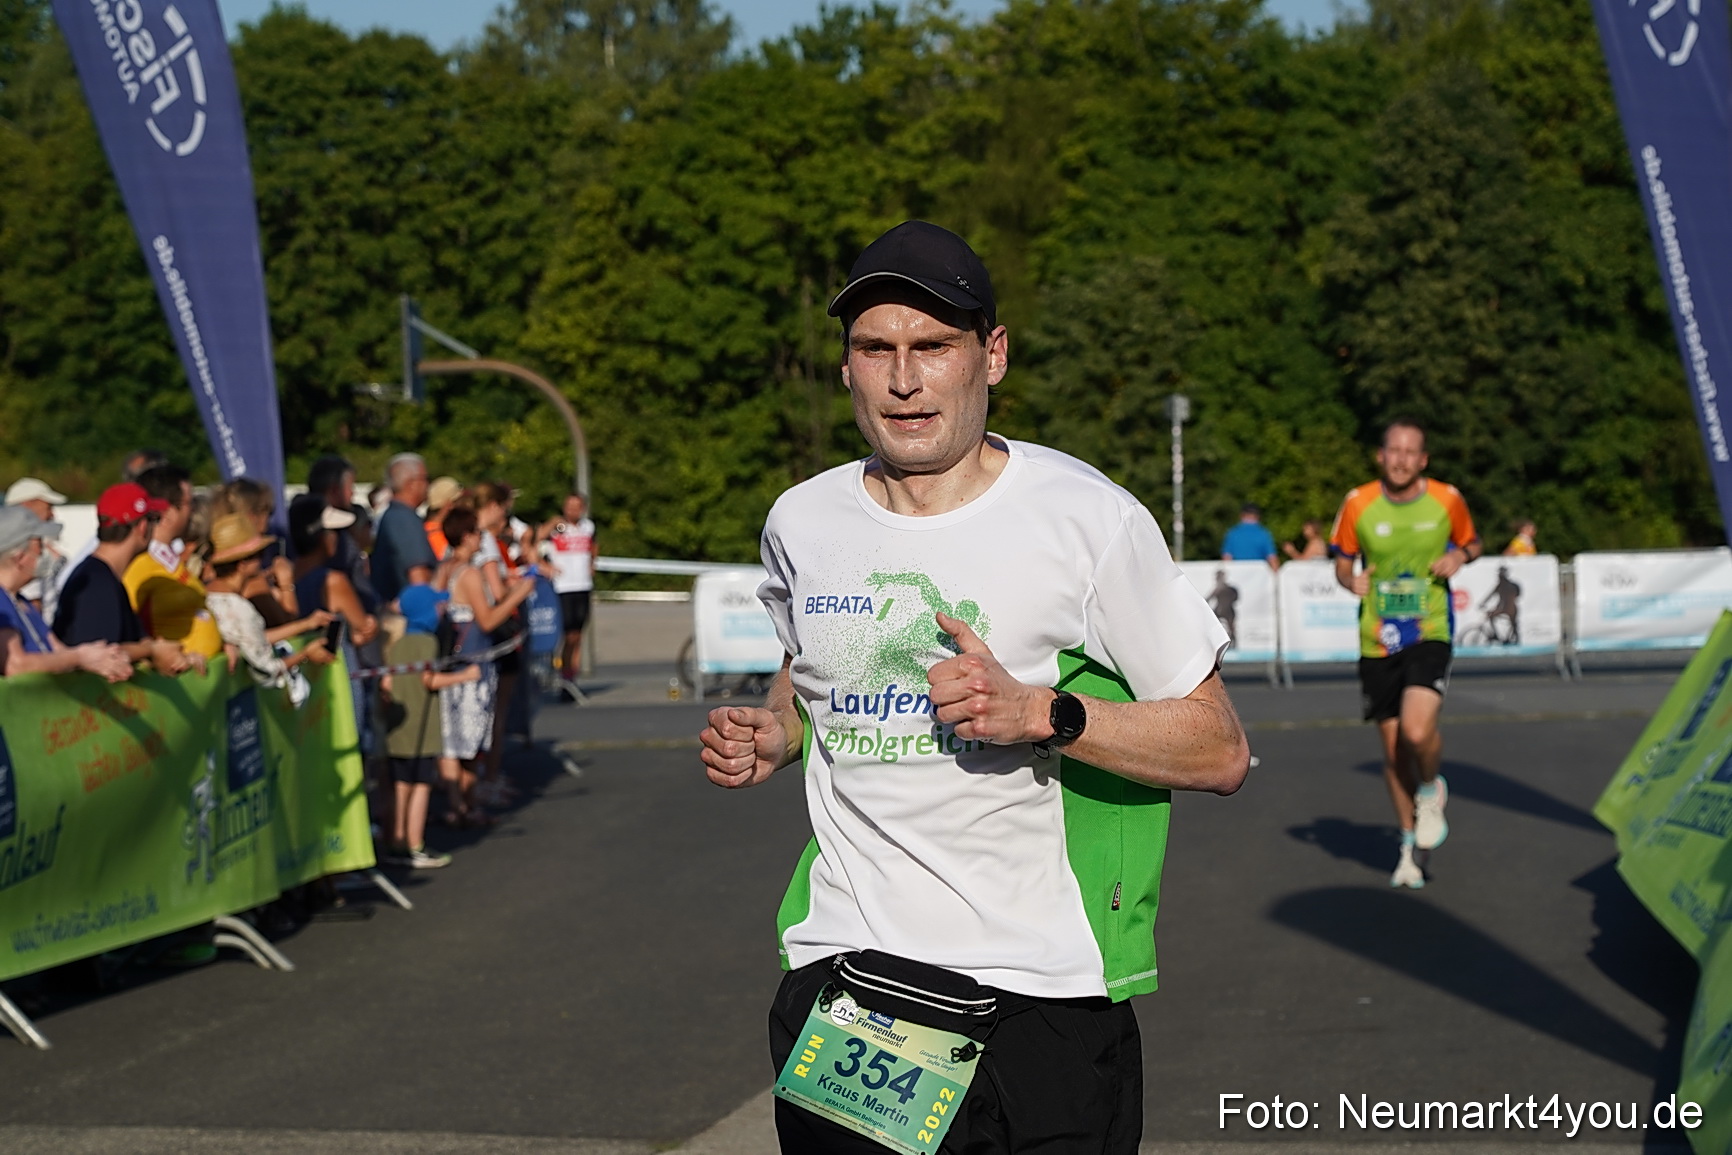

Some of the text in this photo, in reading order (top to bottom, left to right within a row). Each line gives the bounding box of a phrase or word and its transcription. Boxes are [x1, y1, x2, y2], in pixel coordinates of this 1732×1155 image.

[805, 595, 874, 615] BERATA
[830, 684, 940, 722] Laufen
[856, 1017, 909, 1044] Firmenlauf
[872, 1033, 903, 1049] neumarkt
[793, 1034, 825, 1079] RUN
[834, 1037, 924, 1105] 354
[817, 1074, 860, 1102] Kraus
[862, 1094, 910, 1127] Martin
[824, 1097, 846, 1111] BERATA
[917, 1087, 956, 1145] 2022
